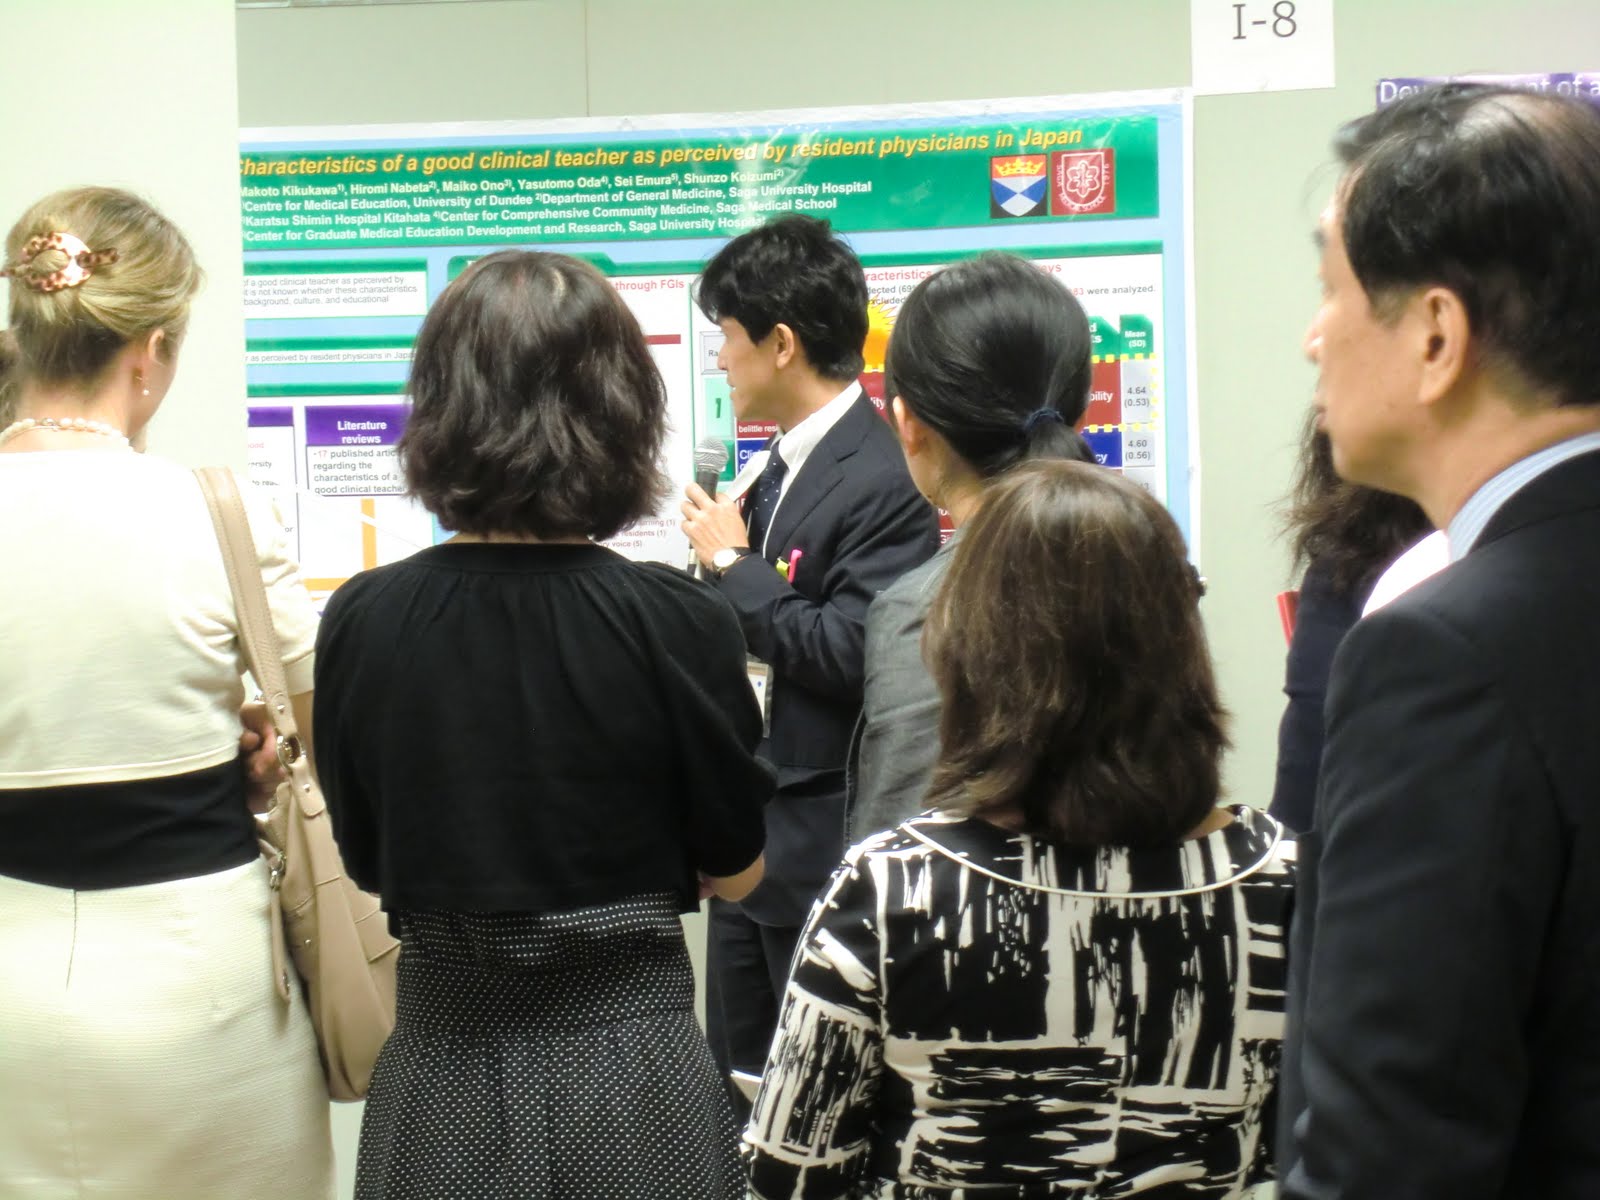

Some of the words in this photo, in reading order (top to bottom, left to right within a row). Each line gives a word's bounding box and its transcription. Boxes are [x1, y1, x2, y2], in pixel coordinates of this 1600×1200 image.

[1232, 0, 1297, 40] I-8
[383, 154, 404, 172] of
[406, 157, 418, 171] a
[422, 152, 475, 175] good
[480, 149, 550, 170] clinical
[555, 148, 629, 168] teacher
[633, 150, 656, 165] as
[660, 143, 758, 167] perceived
[763, 142, 787, 163] by
[791, 137, 874, 158] resident
[879, 131, 989, 158] physicians
[996, 129, 1014, 148] in
[1020, 128, 1082, 149] Japan
[350, 183, 388, 195] Hiromi
[442, 181, 478, 192] Maiko
[517, 177, 575, 190] Yasutomo
[614, 175, 632, 187] Sei
[684, 172, 728, 185] Shunzo
[285, 200, 302, 211] for
[304, 199, 348, 211] Medical
[351, 197, 410, 209] Education,
[413, 196, 471, 209] University
[475, 196, 487, 206] of
[490, 194, 533, 206] Dundee
[612, 190, 624, 202] of
[626, 190, 669, 202] General
[672, 188, 726, 200] Medicine,
[729, 187, 757, 199] Saga
[761, 183, 819, 196] University
[822, 181, 872, 195] Hospital
[292, 214, 332, 226] Shimin
[335, 213, 381, 226] Hospital
[384, 212, 431, 223] Kitahata
[482, 209, 498, 221] for
[501, 208, 590, 221] Comprehensive
[593, 206, 658, 218] Community
[660, 203, 713, 216] Medicine,
[716, 202, 746, 215] Saga
[748, 200, 792, 211] Medical
[795, 198, 837, 210] School
[286, 229, 302, 241] for
[305, 229, 357, 240] Graduate
[360, 227, 403, 239] Medical
[406, 226, 464, 238] Education
[467, 224, 542, 237] Development
[544, 223, 565, 235] and
[568, 222, 626, 234] Research,
[629, 220, 657, 233] Saga
[660, 218, 716, 231] University
[258, 279, 277, 288] good
[280, 278, 307, 286] clinical
[309, 277, 339, 286] teacher
[353, 276, 392, 285] perceived
[394, 276, 404, 284] by
[615, 280, 657, 291] through
[258, 288, 271, 296] not
[273, 287, 299, 296] known
[301, 286, 333, 295] whether
[335, 286, 357, 294] these
[359, 284, 418, 293] characteristics
[326, 296, 341, 304] and
[343, 295, 389, 303] educational
[1128, 340, 1146, 348] (SD)
[261, 353, 297, 362] perceived
[299, 353, 308, 363] by
[311, 352, 340, 360] resident
[343, 352, 382, 361] physicians
[337, 421, 388, 431] Literature
[738, 425, 763, 433] belittle
[342, 434, 382, 444] reviews
[330, 450, 374, 459] published
[313, 462, 357, 472] regarding
[314, 473, 379, 482] characteristics
[382, 472, 390, 480] of
[340, 485, 371, 493] clinical
[621, 530, 655, 538] residents
